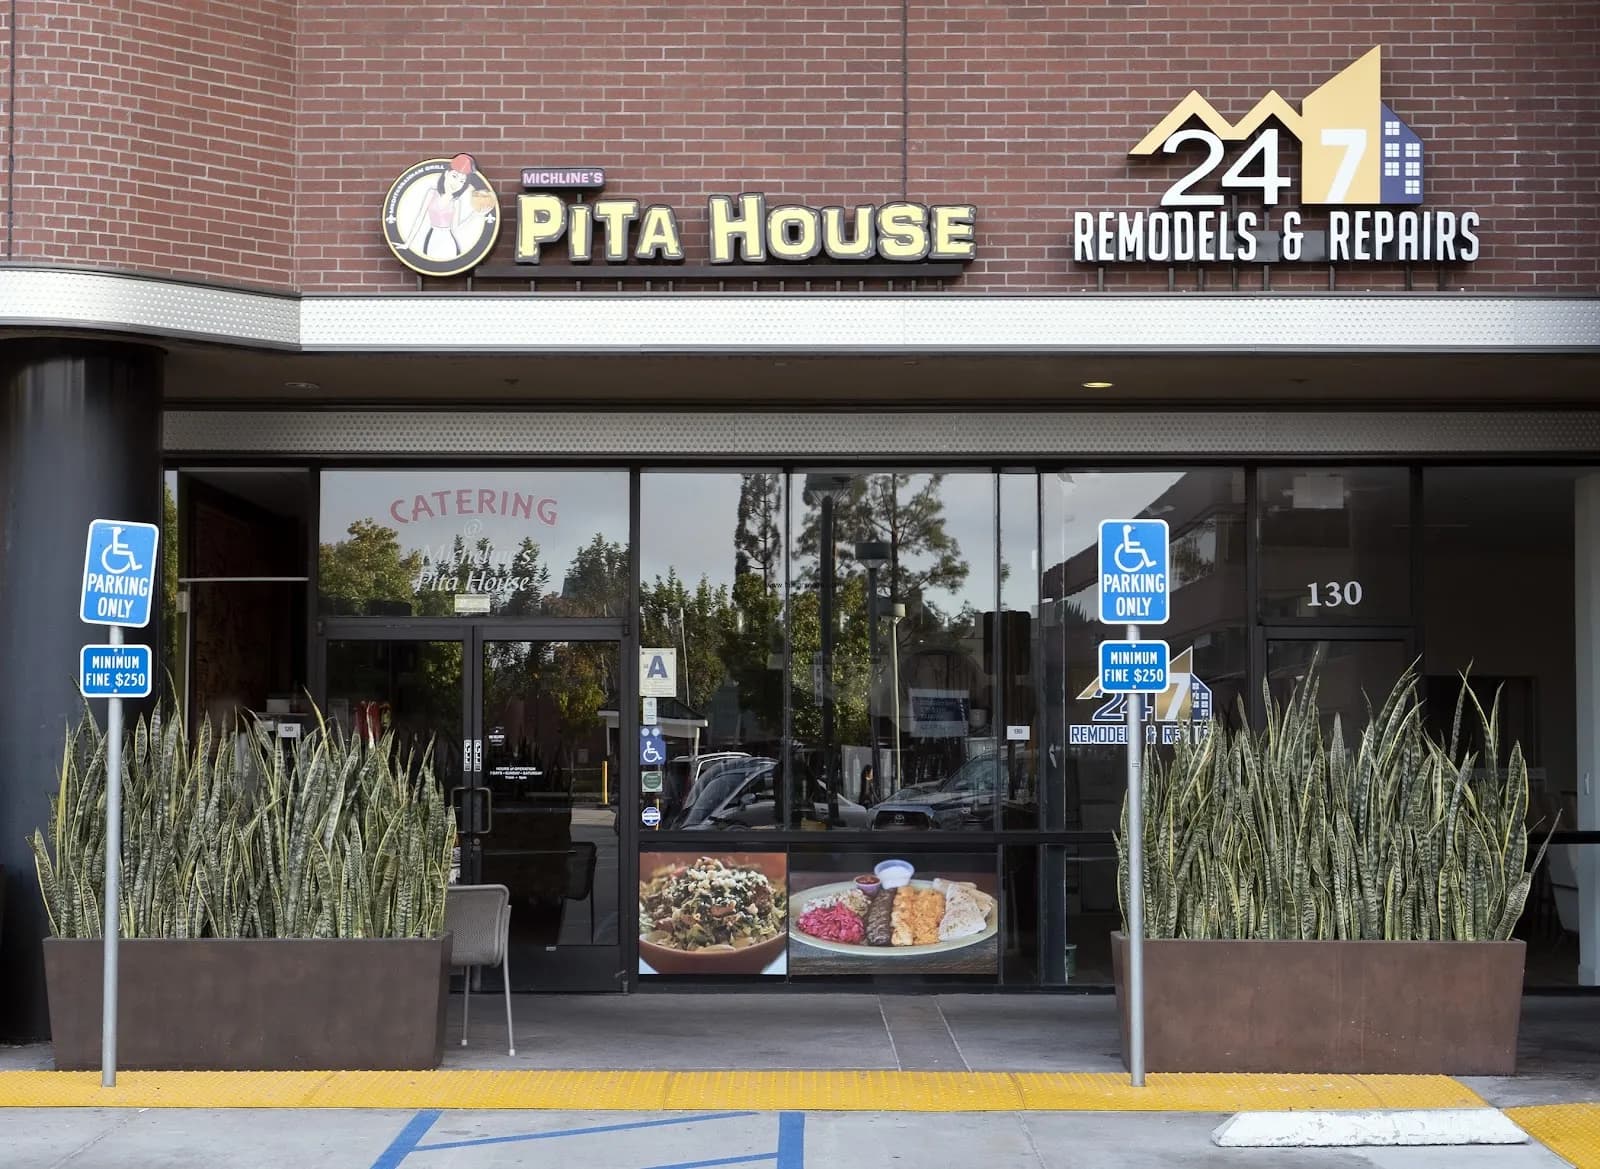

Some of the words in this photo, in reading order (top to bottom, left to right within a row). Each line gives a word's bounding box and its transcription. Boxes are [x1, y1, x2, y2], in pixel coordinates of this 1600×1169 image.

[522, 172, 603, 185] MICHLINE'S
[515, 193, 685, 264] PITA
[708, 192, 976, 264] HOUSE
[1073, 211, 1257, 262] REMODELS
[1282, 211, 1304, 262] &
[1329, 211, 1480, 262] REPAIRS
[390, 489, 558, 526] CATERING
[87, 573, 149, 597] PARKING
[413, 571, 459, 593] Pita
[465, 570, 530, 593] House
[1103, 573, 1165, 593] PARKING
[1306, 580, 1362, 607] 130
[97, 598, 134, 619] ONLY
[1115, 596, 1152, 617] ONLY
[92, 655, 140, 669] MINIMUM
[647, 655, 668, 679] A
[1110, 651, 1158, 665] MINIMUM
[85, 672, 110, 687] FINE
[115, 671, 145, 688] $250
[1104, 668, 1129, 682] FINE
[1134, 667, 1164, 683] $250
